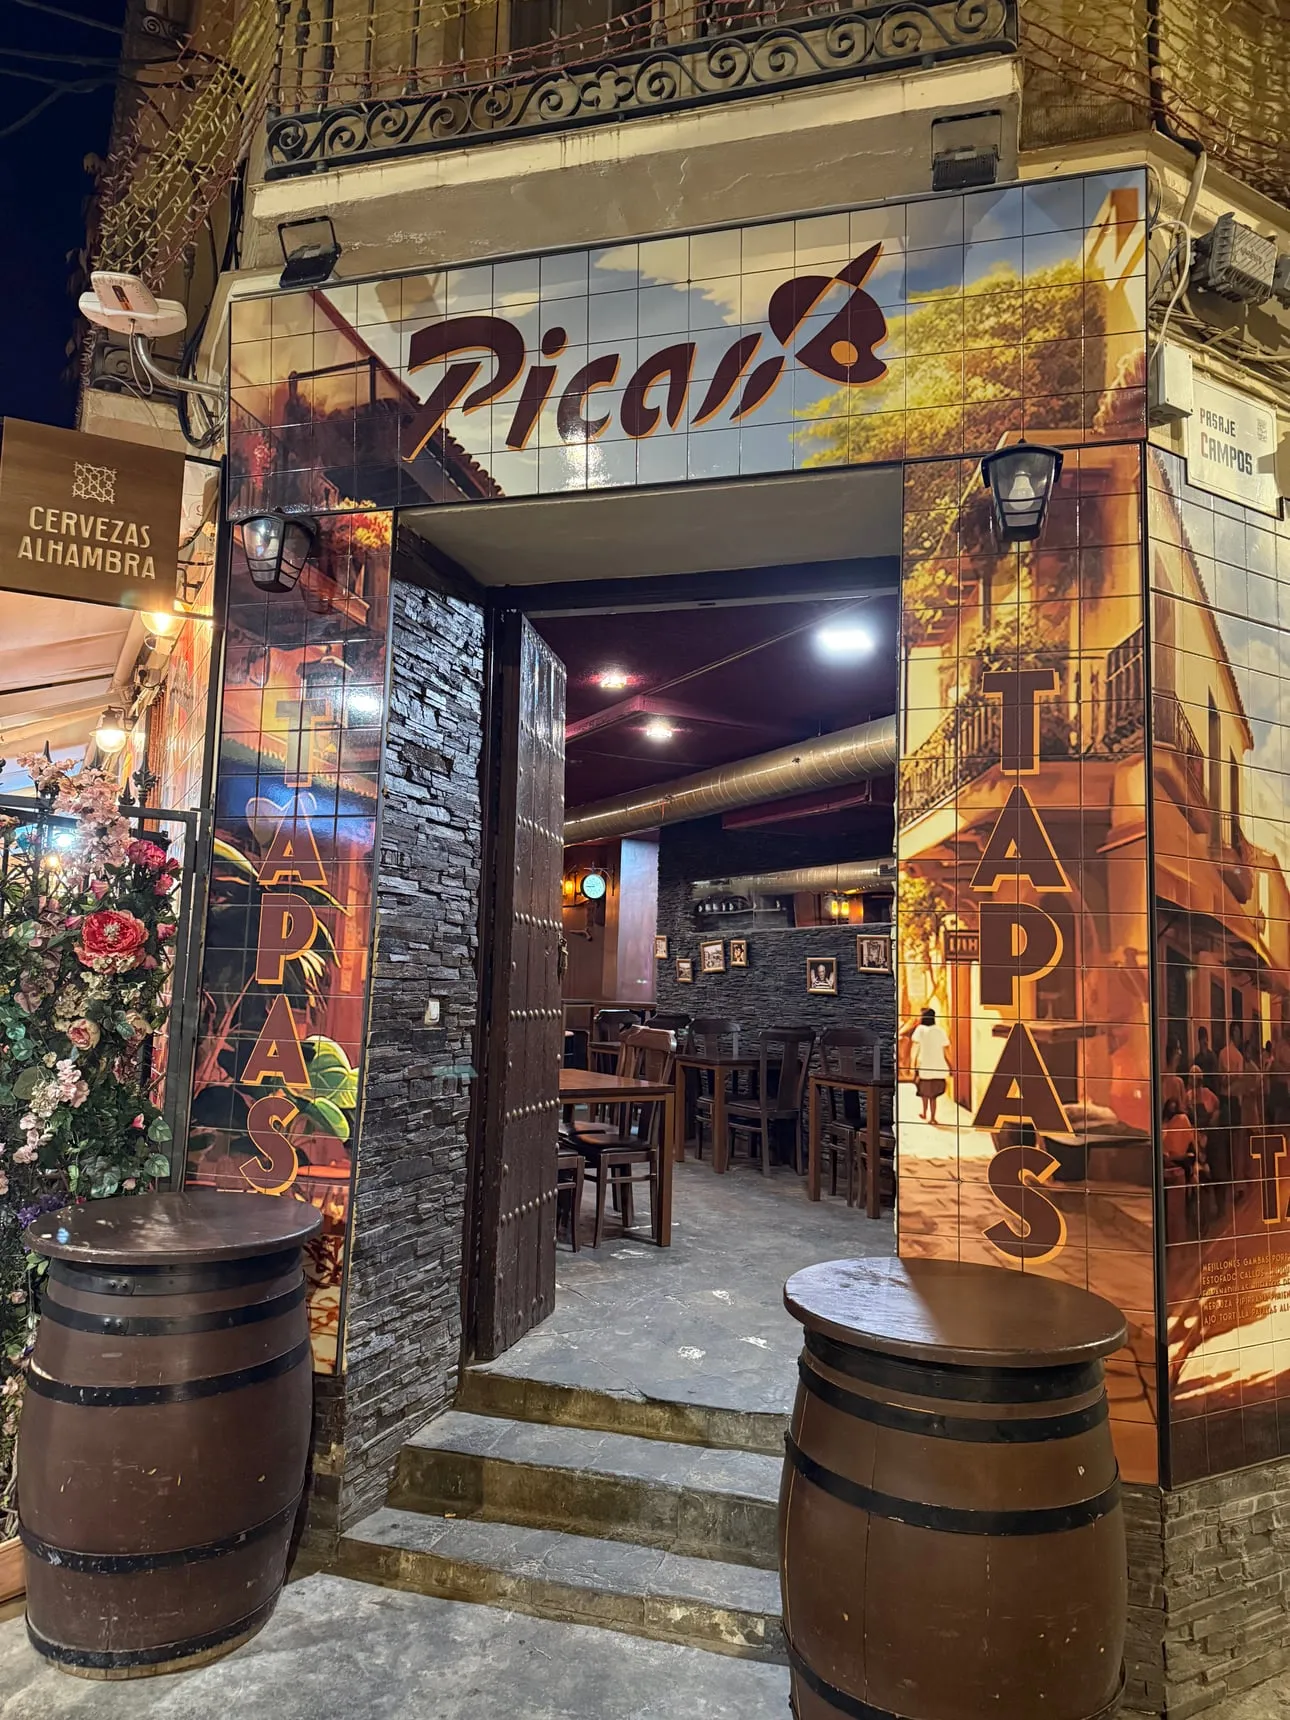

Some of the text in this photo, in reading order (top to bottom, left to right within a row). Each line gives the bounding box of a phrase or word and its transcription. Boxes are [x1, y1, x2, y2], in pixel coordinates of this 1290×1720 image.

[1199, 407, 1236, 438] PASAJE
[1201, 431, 1253, 476] CAMPOS
[28, 505, 151, 549] CERVEZAS
[17, 535, 157, 580] ALHAMBRA
[239, 698, 334, 1196] TAPAS
[969, 669, 1076, 1265] TAPAS
[1202, 1259, 1240, 1273] MEJILLONES
[1243, 1255, 1269, 1266] GAMBAS
[1202, 1272, 1237, 1286] ESTOFADO
[1240, 1270, 1264, 1280] CALLOS
[1204, 1314, 1217, 1326] AJO
